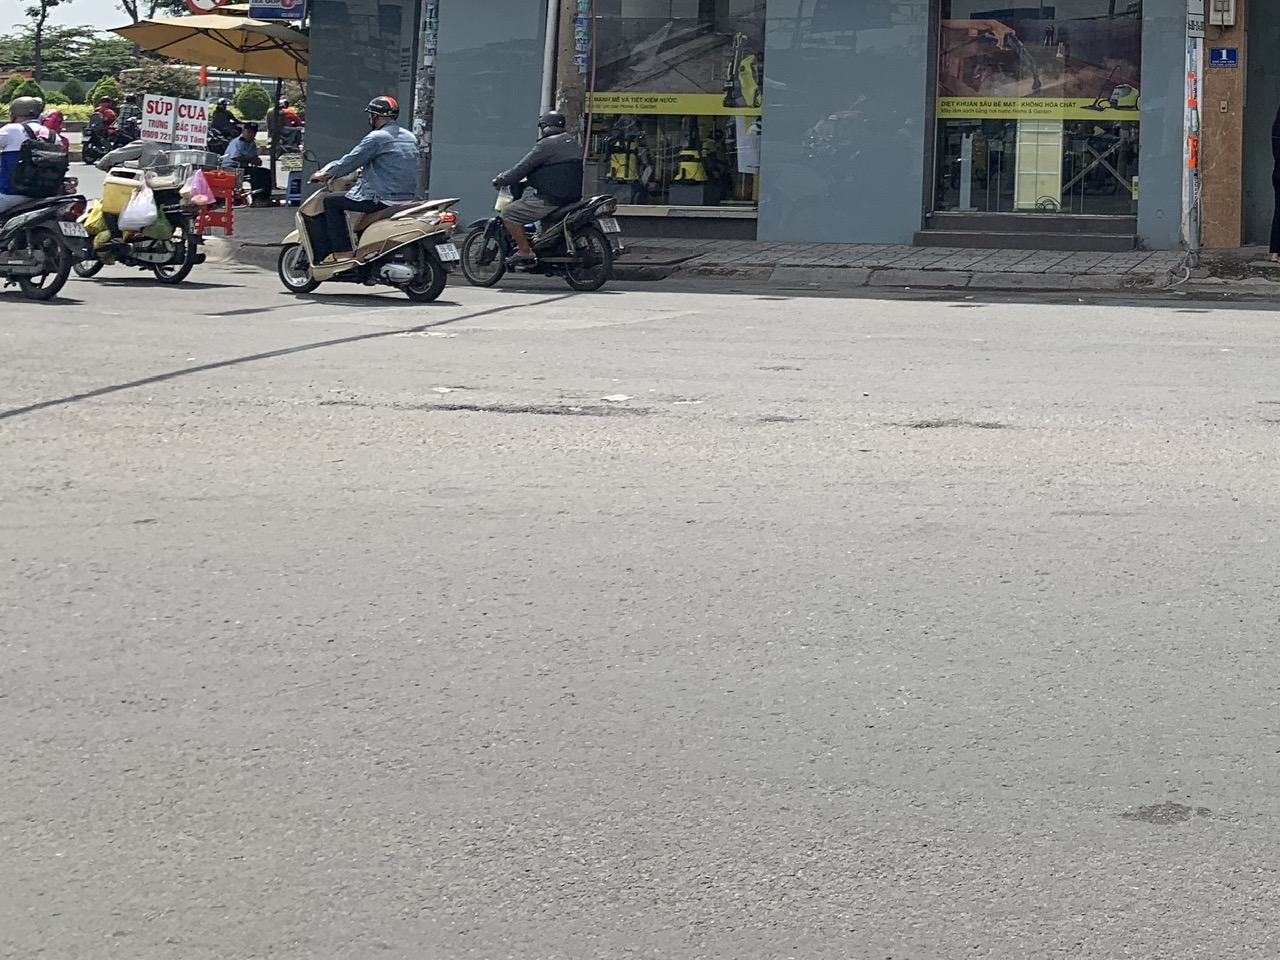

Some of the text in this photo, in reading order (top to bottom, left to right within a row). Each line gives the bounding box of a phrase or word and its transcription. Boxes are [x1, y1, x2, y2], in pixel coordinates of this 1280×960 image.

[1220, 49, 1229, 60] 1
[146, 97, 207, 121] SÚP CUA
